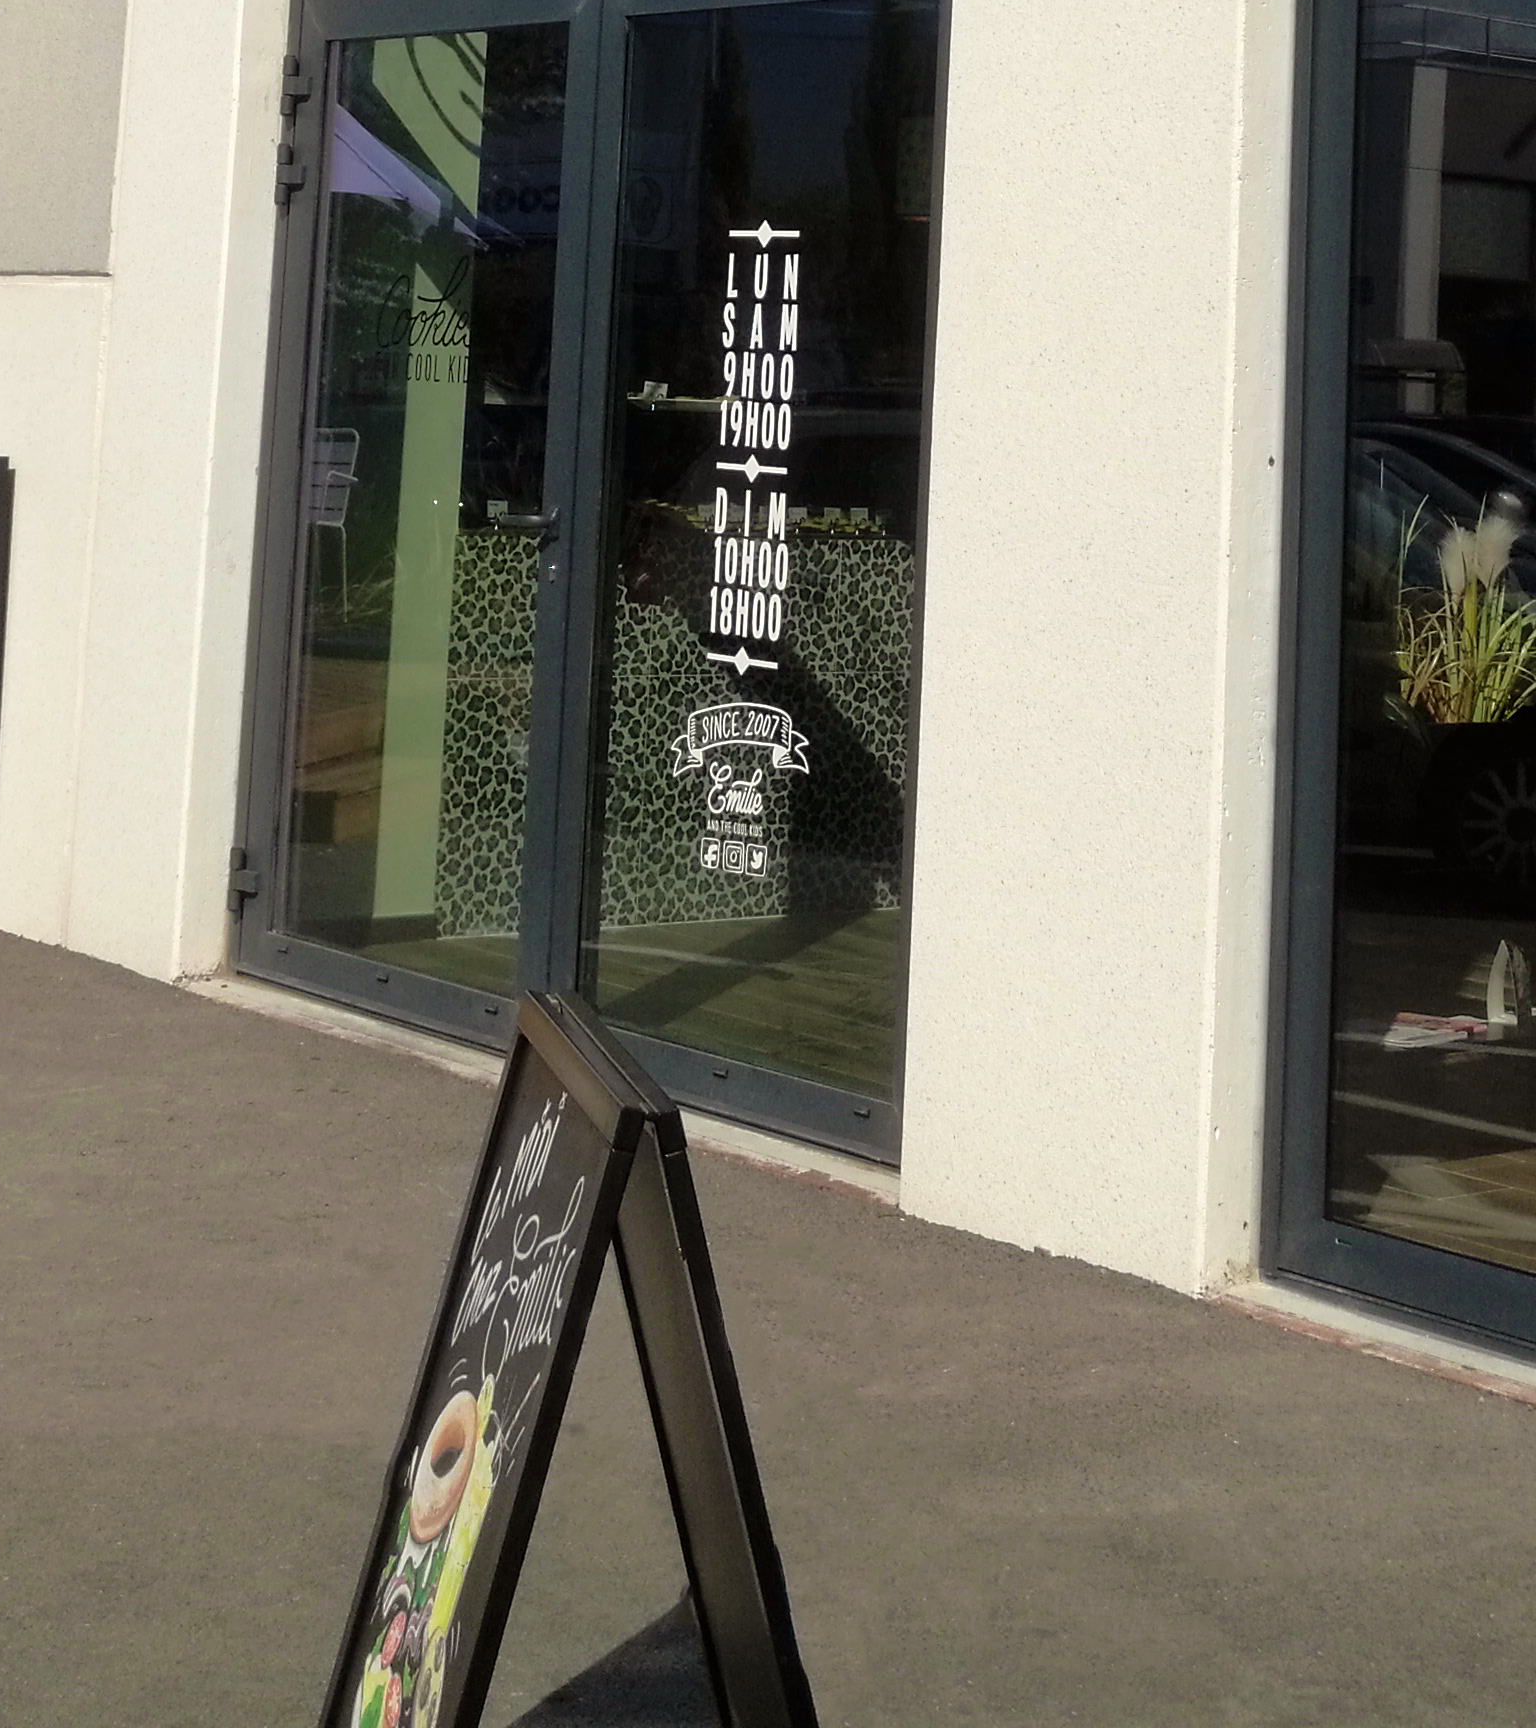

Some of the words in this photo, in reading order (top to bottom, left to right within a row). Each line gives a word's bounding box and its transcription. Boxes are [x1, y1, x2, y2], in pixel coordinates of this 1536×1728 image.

[727, 252, 799, 300] LUN
[722, 302, 798, 351] SAM
[406, 353, 440, 382] COOL
[723, 351, 794, 401] 9H00
[720, 400, 791, 450] 19H00
[714, 487, 786, 541] DIM
[714, 536, 789, 590] 10H00
[710, 586, 781, 641] 18H00
[702, 711, 740, 743] SINCE
[745, 711, 779, 740] 2007
[707, 761, 763, 815] Emilie
[706, 820, 719, 831] AND
[720, 821, 732, 833] THE
[733, 823, 747, 836] COOL
[749, 825, 763, 837] KIDS
[482, 1175, 585, 1382] Emilie
